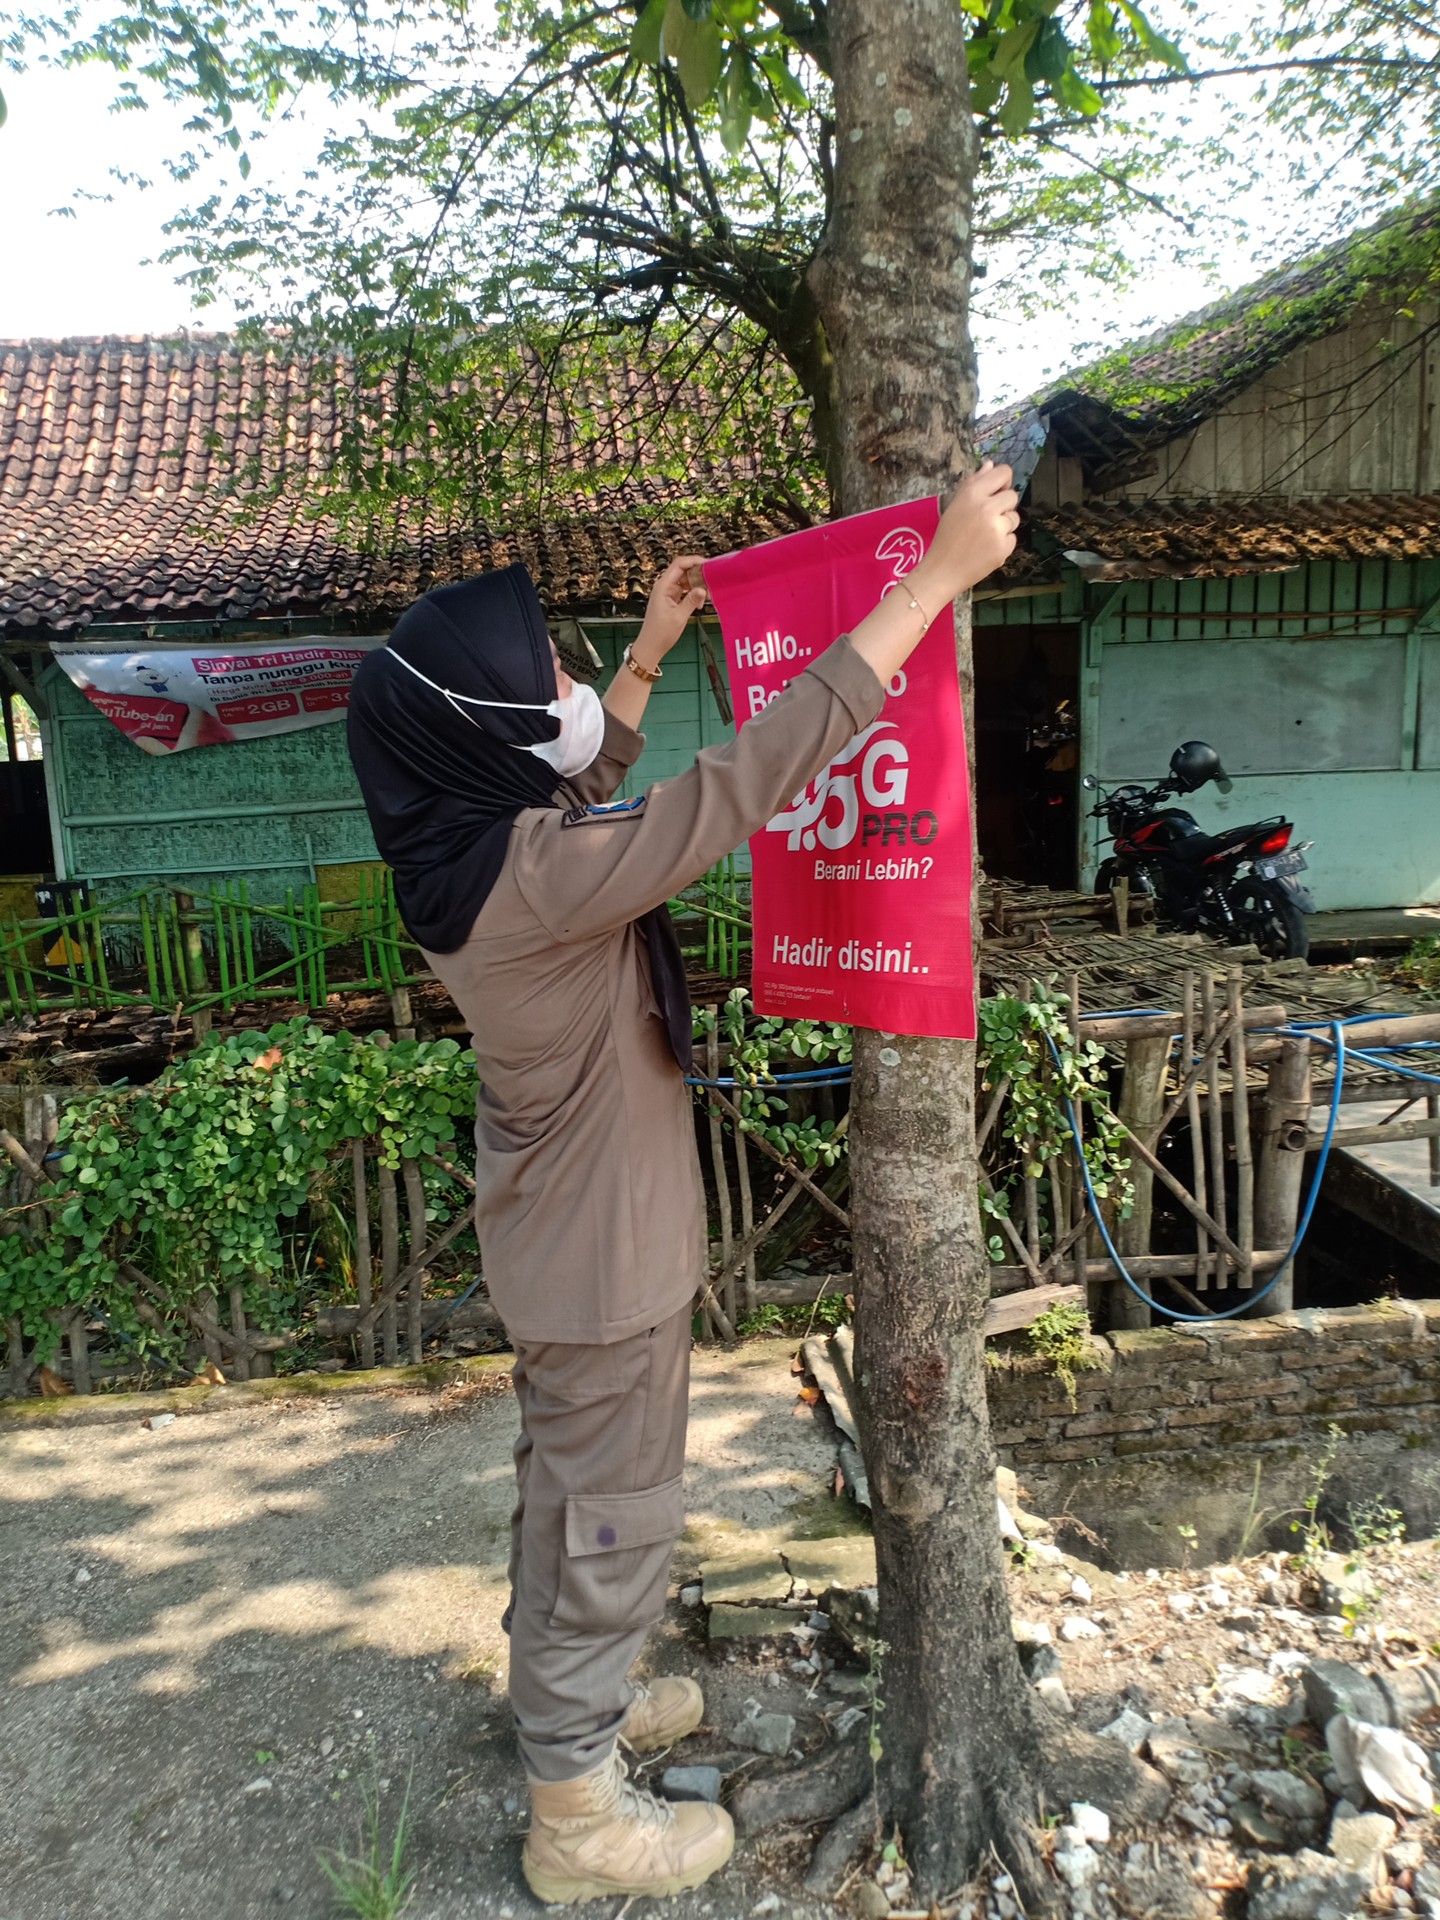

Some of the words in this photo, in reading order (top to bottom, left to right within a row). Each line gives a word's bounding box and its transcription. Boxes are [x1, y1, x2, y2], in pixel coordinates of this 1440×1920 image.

[197, 658, 251, 673] Sinyal
[253, 654, 279, 667] Tri
[281, 649, 326, 664] Hadir
[734, 630, 812, 669] Hallo..
[198, 673, 240, 685] Tanpa
[258, 662, 325, 679] nunggu
[861, 809, 939, 848] PRO
[813, 859, 861, 881] Berani
[864, 856, 934, 880] Lebih?
[772, 934, 833, 968] Hadir
[837, 938, 929, 974] disini..
